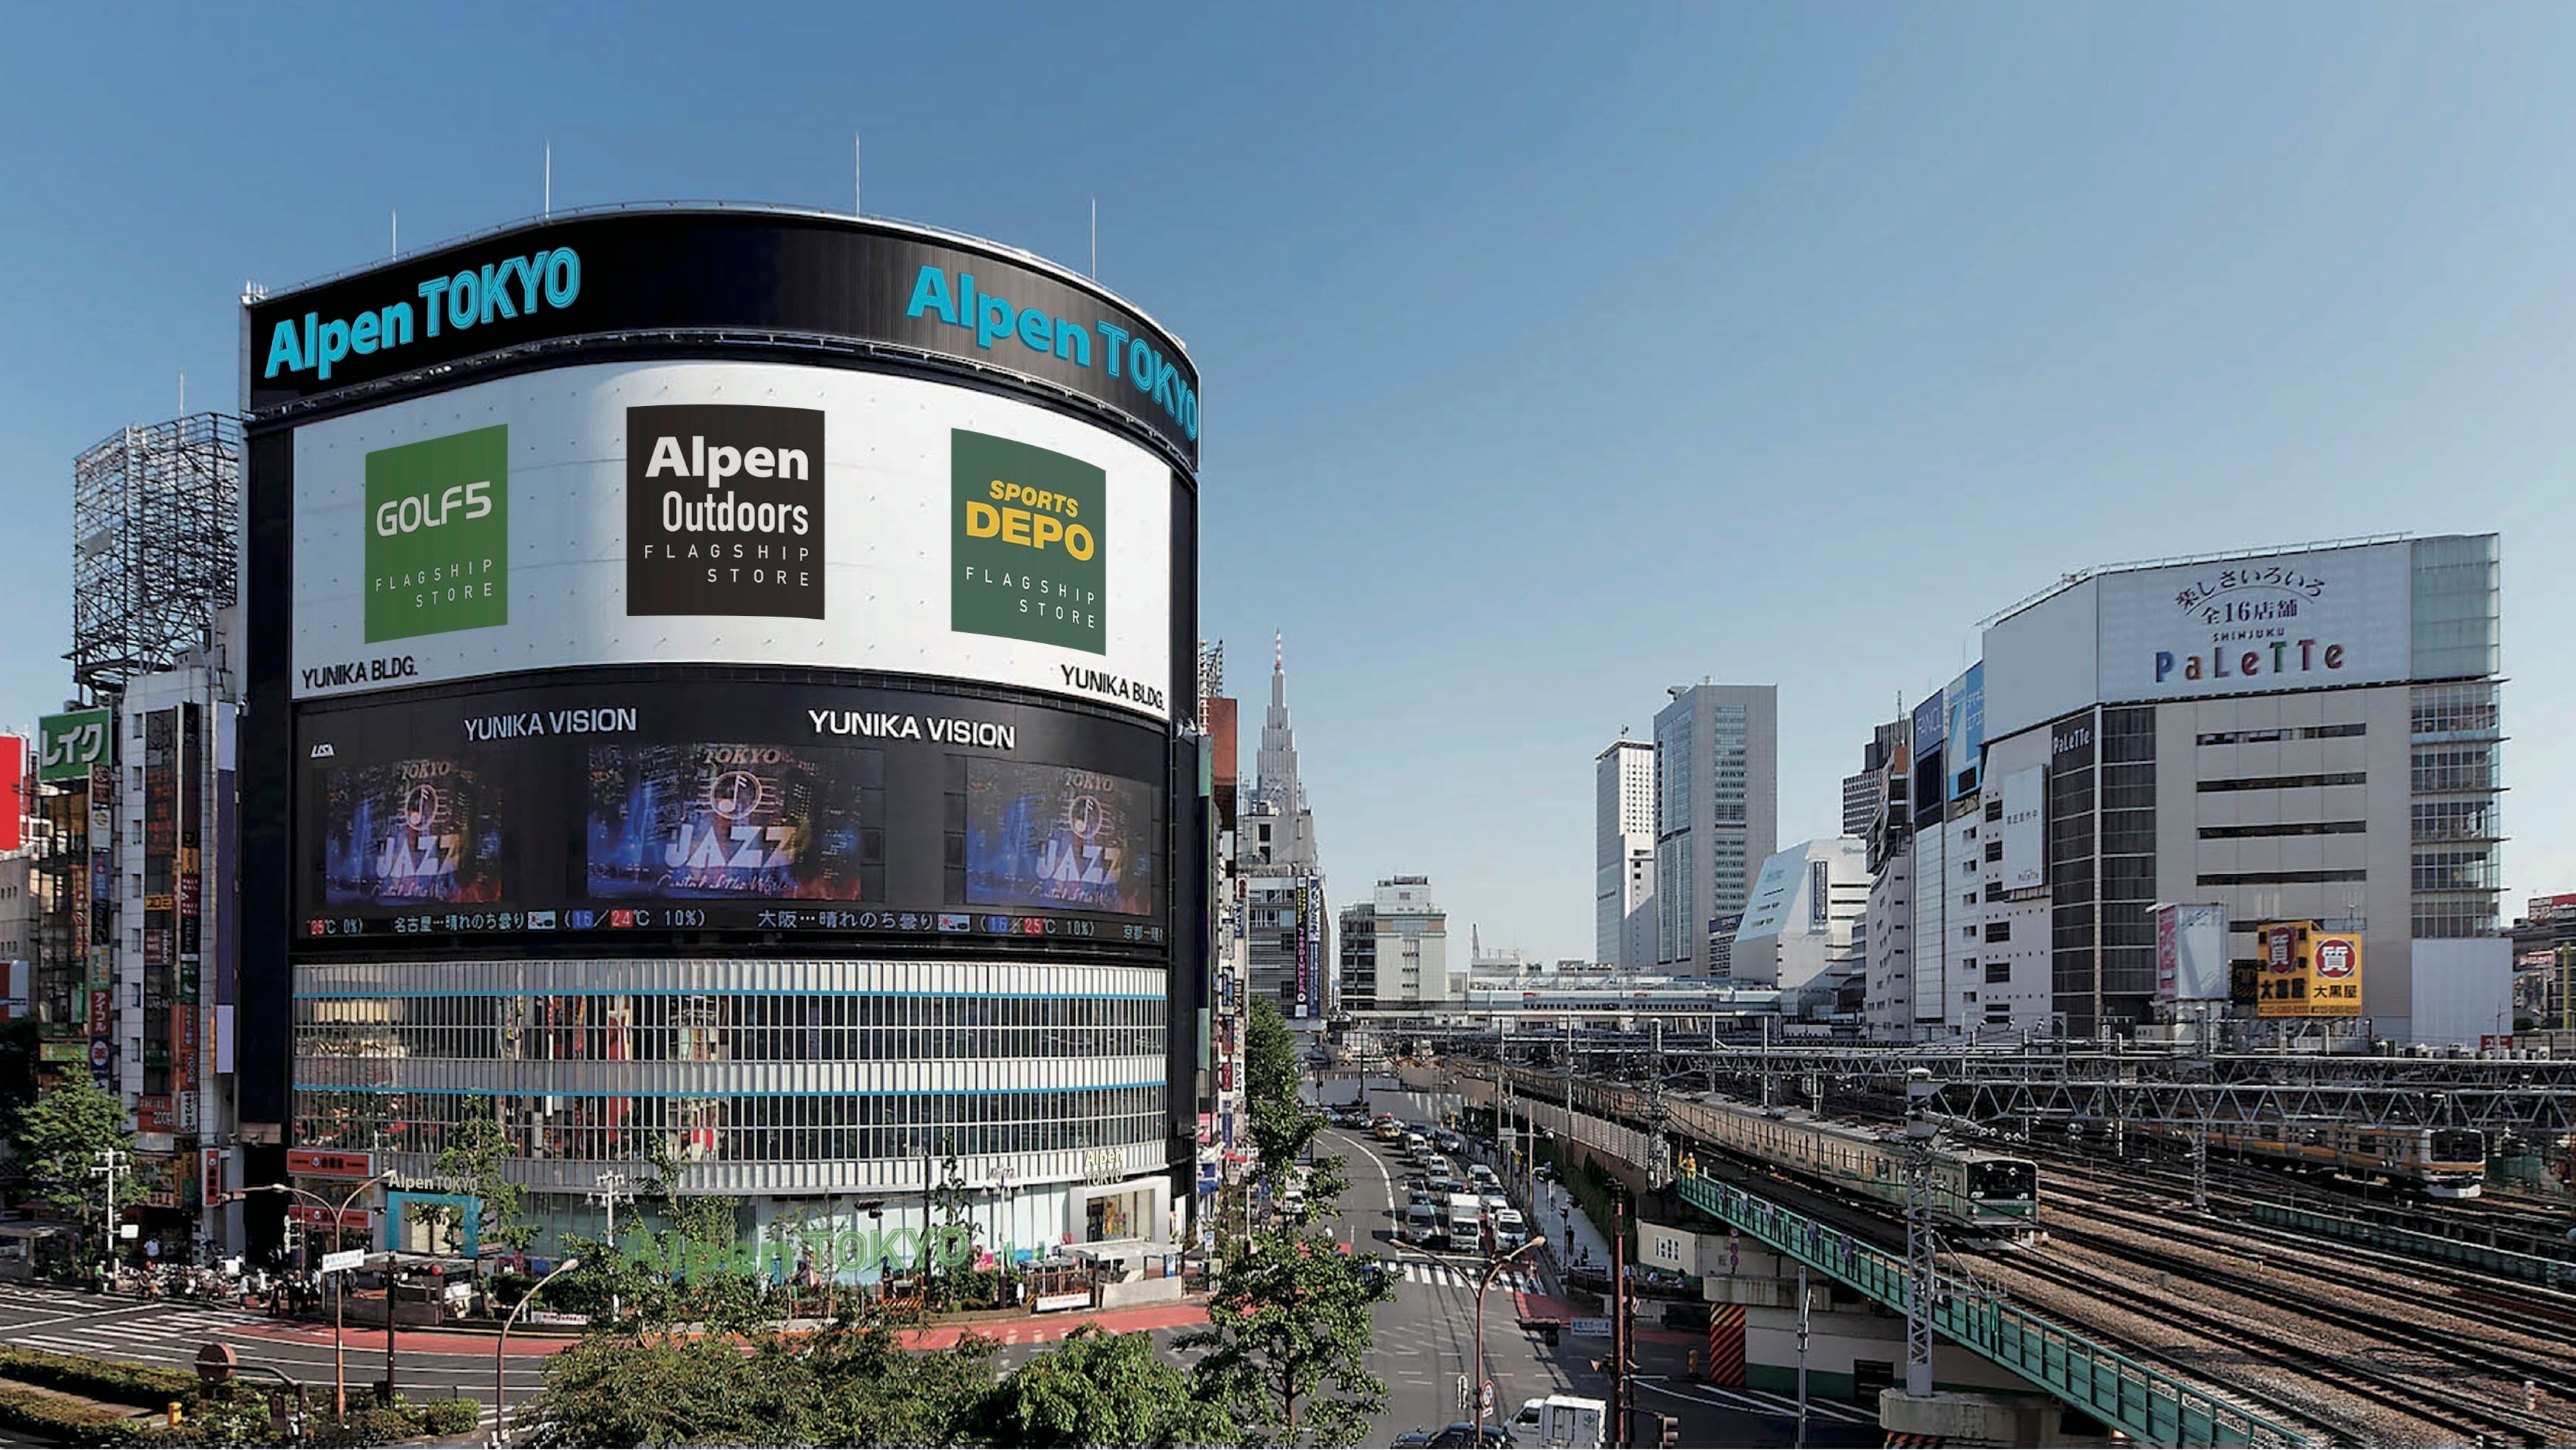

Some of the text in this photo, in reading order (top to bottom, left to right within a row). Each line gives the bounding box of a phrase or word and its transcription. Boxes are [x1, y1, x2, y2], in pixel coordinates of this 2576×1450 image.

[265, 246, 581, 379] Alpen TOKYO
[906, 265, 1199, 441] Alpen TOKYO
[645, 435, 810, 488] Alpen
[376, 480, 493, 538] GOLF5
[662, 490, 810, 535] Outdoors
[989, 479, 1079, 518] SPORTS
[966, 500, 1095, 561] DEPO
[645, 543, 810, 561] FLAGSHIP
[375, 558, 492, 592] FLAGSHIP
[707, 569, 810, 586] STORE
[966, 566, 1095, 605] FLAGSHIP
[2175, 566, 2325, 610] 楽しさいろいろ
[416, 582, 492, 608] STORE
[2200, 598, 2298, 625] 全16店舗
[1020, 599, 1095, 629] STORE
[2212, 627, 2285, 643] SHINJUKU
[302, 655, 418, 689] YUNIKA BLDG.
[1060, 663, 1166, 711] YUNIKA BLDG.
[464, 708, 637, 740] YUNIKA VISION
[808, 709, 1017, 750] YUNIKA VISION
[41, 722, 103, 767] レイク
[703, 748, 781, 765] TOKYO
[401, 760, 452, 779] TOKYO
[1064, 773, 1114, 792] TOKYO
[376, 833, 461, 878] JAZZ
[665, 824, 799, 868] JAZZ
[1036, 839, 1122, 884] JAZZ
[2321, 945, 2349, 972] 質
[2314, 985, 2357, 998] 大黒屋
[1085, 1149, 1123, 1169] Alpen
[388, 1173, 478, 1192] Alpen TOKYO
[1085, 1168, 1124, 1188] TOKYO
[803, 1227, 970, 1272] TOKYO
